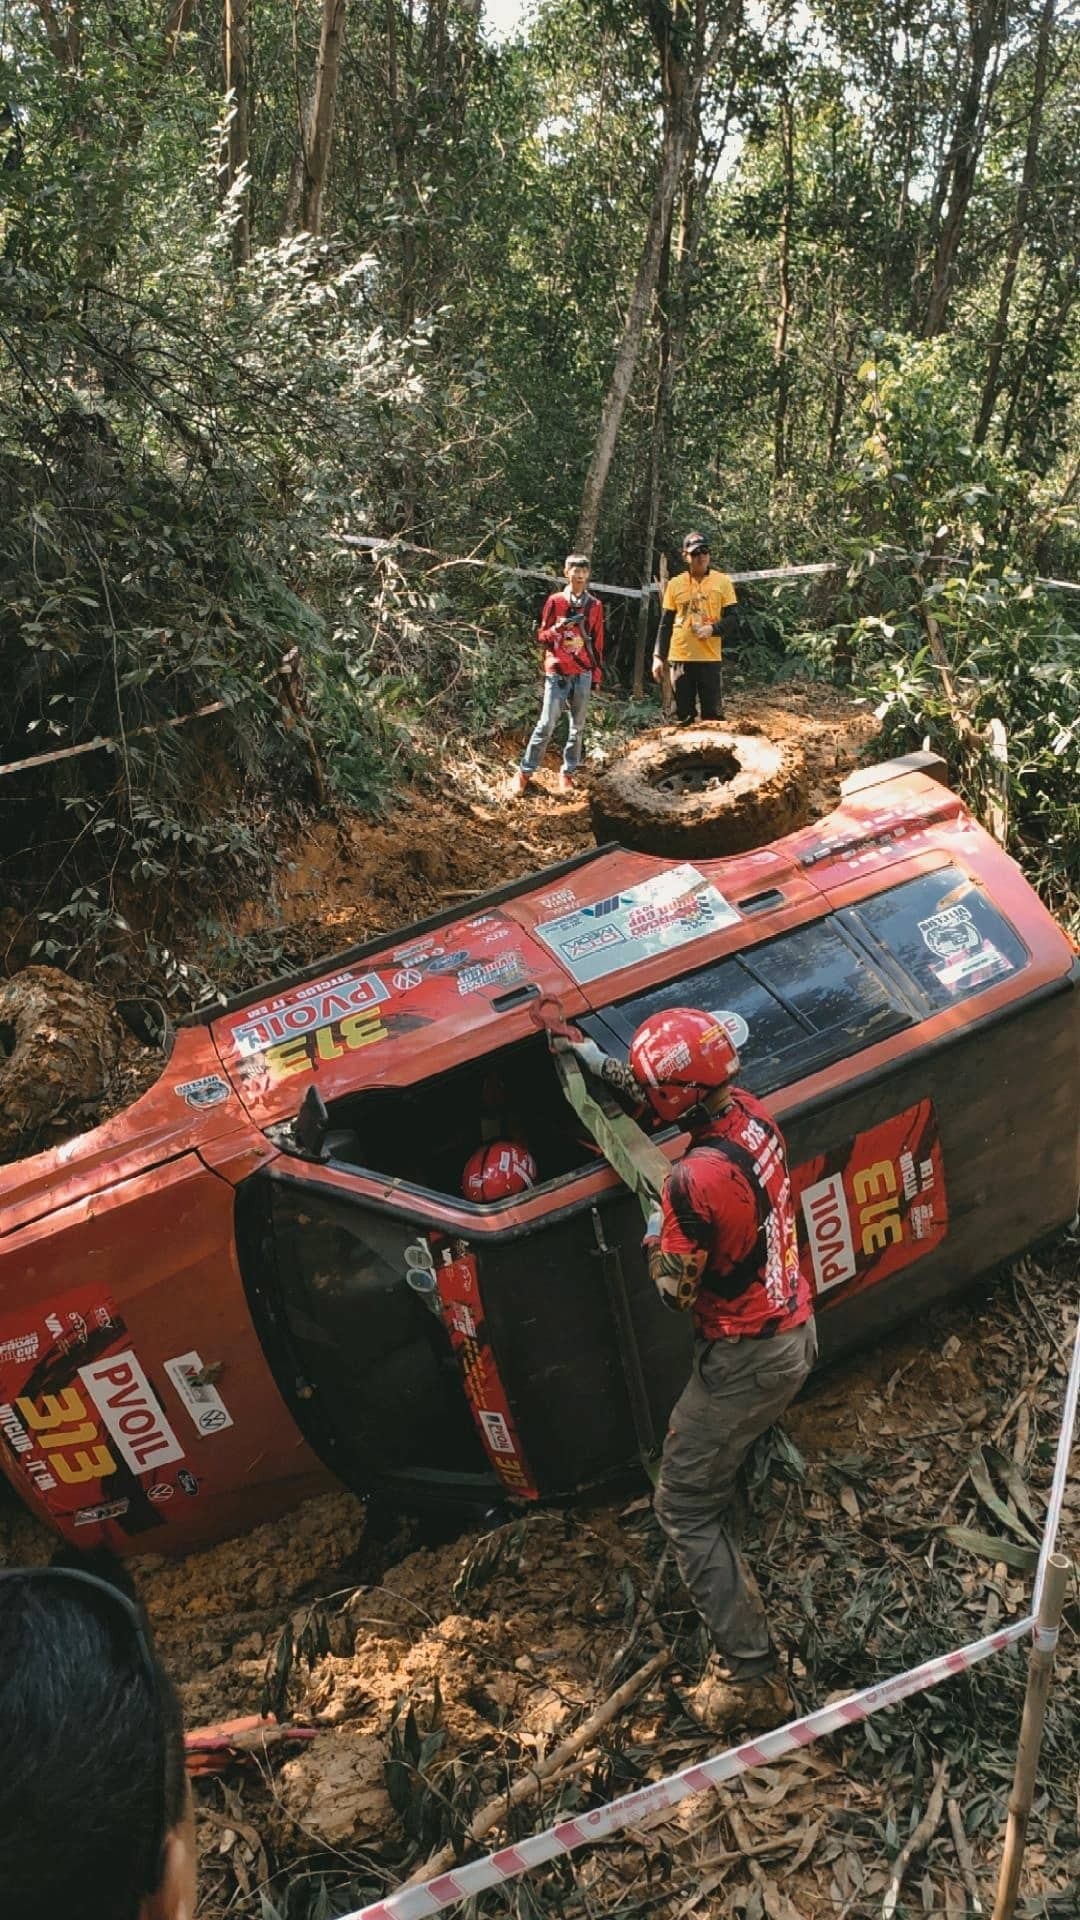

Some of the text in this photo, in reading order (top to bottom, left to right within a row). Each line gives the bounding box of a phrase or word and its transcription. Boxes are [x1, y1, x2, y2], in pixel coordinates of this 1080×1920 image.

[241, 980, 378, 1042] PVOIL
[265, 1006, 389, 1080] 313
[809, 1183, 849, 1284] PVOIL
[853, 1160, 903, 1256] 313
[17, 1344, 39, 1357] CUP
[0, 1403, 34, 1453] VITCLUB
[15, 1387, 118, 1484] 313
[92, 1362, 170, 1466] PVOIL
